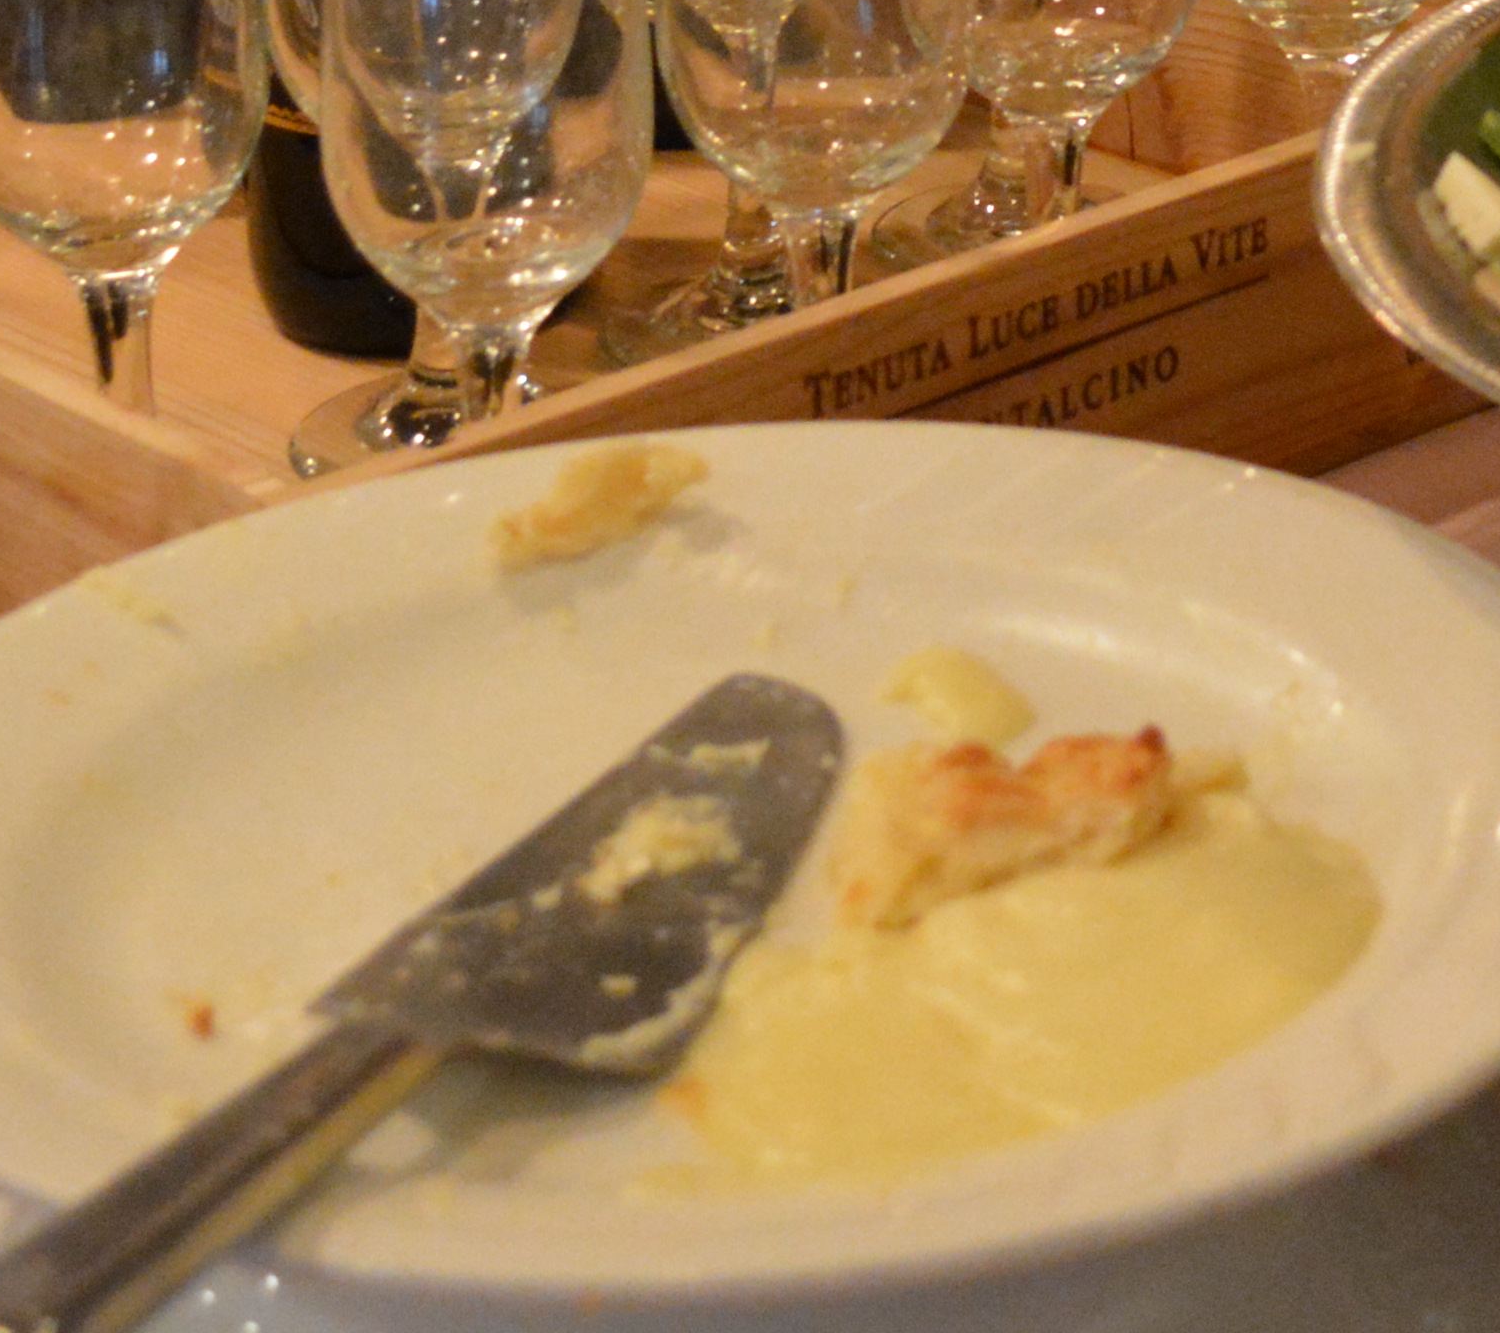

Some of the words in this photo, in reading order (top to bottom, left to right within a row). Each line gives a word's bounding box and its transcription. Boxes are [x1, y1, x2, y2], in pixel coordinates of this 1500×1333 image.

[803, 337, 951, 419] TENUTA
[967, 295, 1060, 359] LUCE
[1074, 254, 1178, 321] DELLA
[1190, 217, 1268, 272] VITE
[983, 344, 1181, 426] TALCINO
